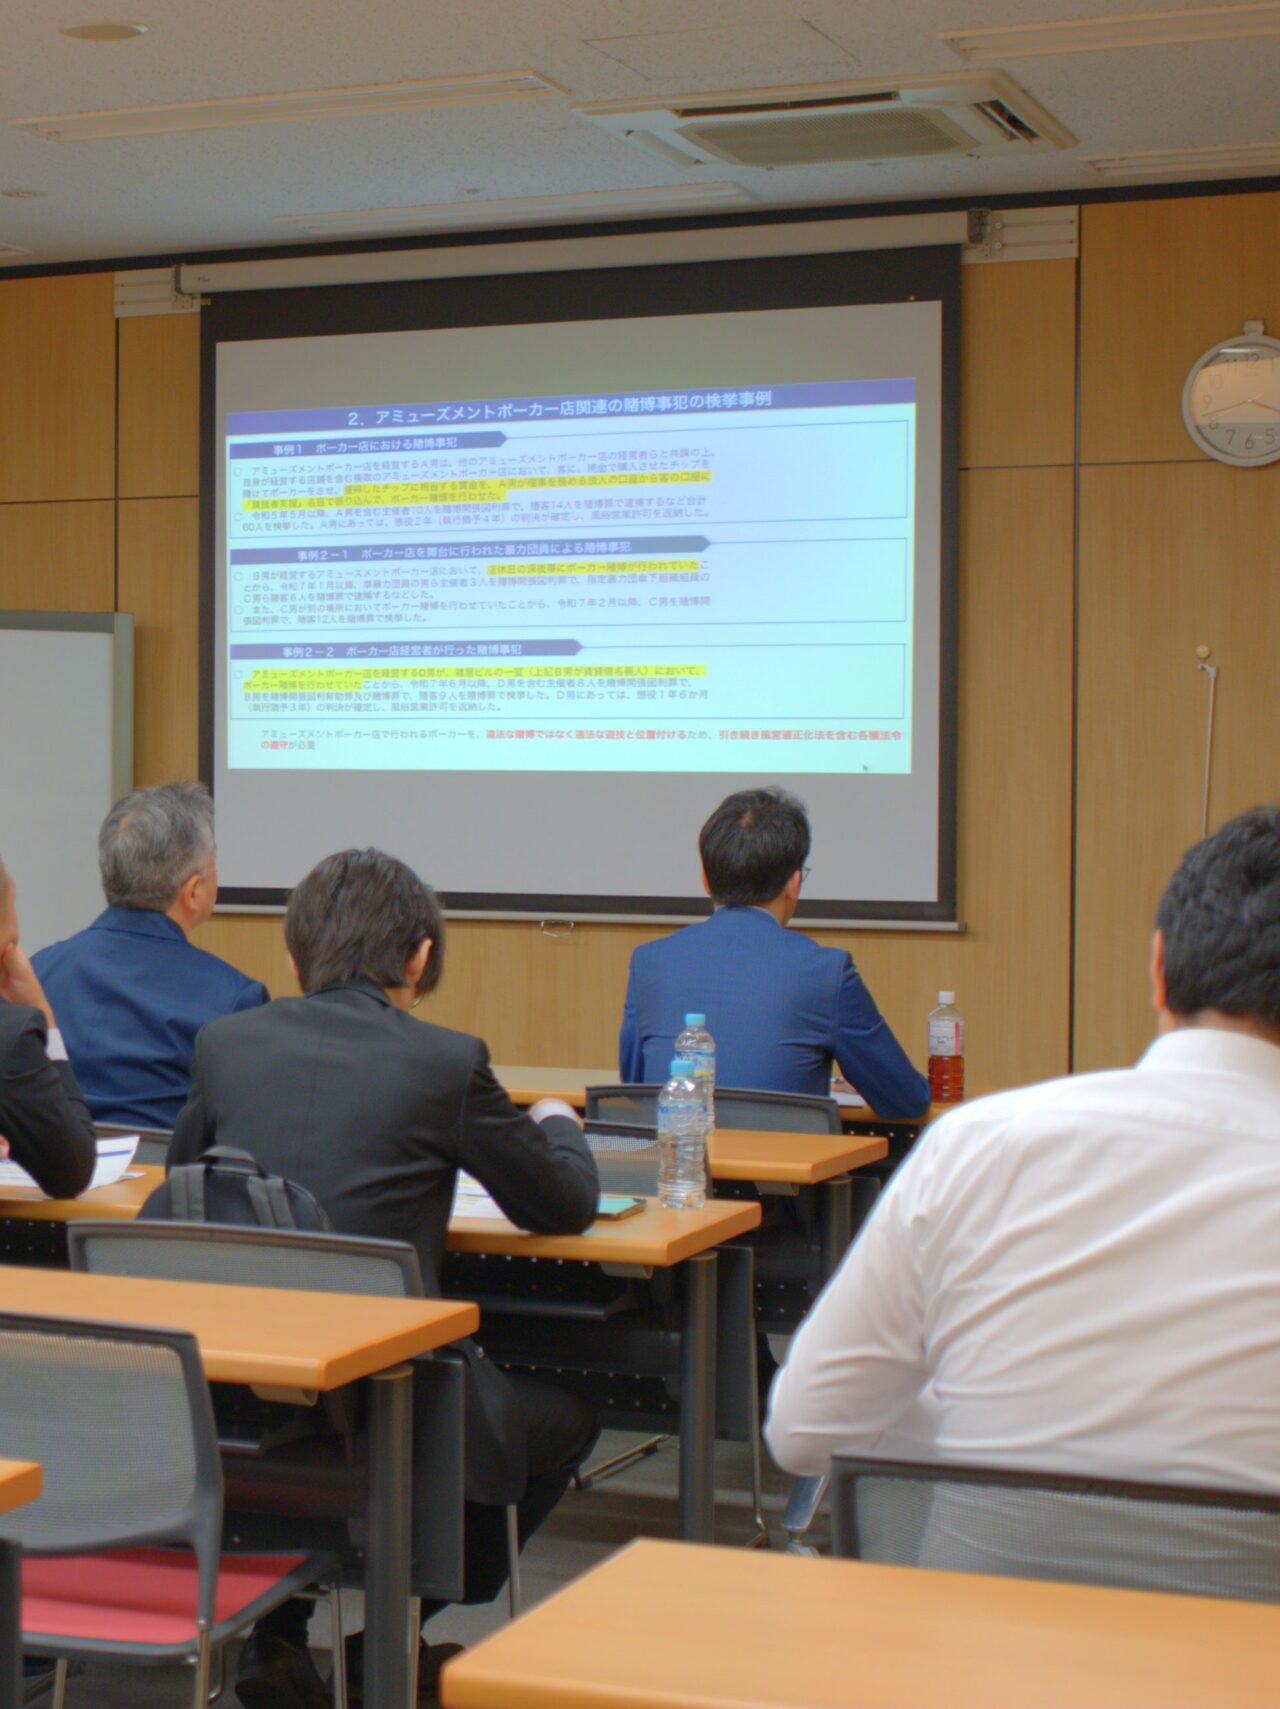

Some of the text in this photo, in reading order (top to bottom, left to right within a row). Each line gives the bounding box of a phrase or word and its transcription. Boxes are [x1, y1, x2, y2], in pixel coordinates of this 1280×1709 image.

[375, 390, 773, 425] アミューズメントポーカー店関連の賭博事犯の検挙事例
[1225, 429, 1236, 445] 7
[1244, 433, 1255, 449] 6
[1264, 428, 1276, 445] 5
